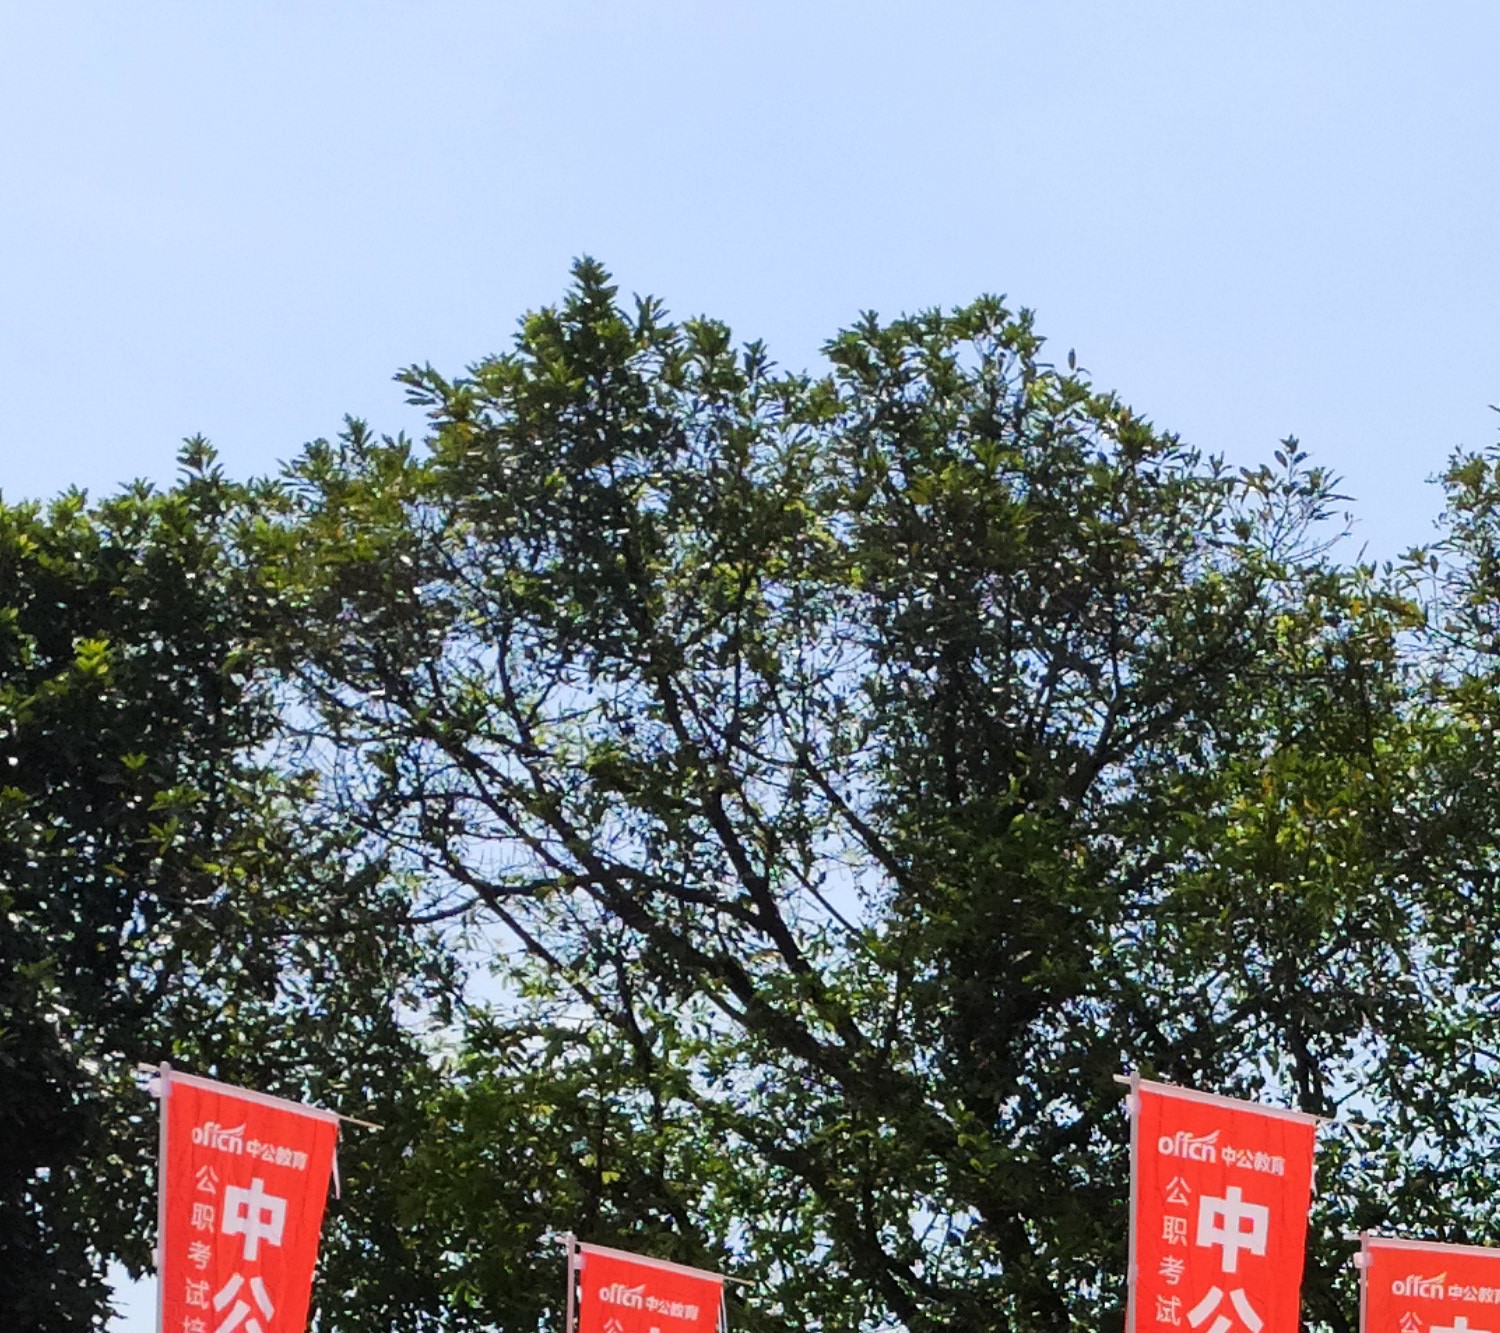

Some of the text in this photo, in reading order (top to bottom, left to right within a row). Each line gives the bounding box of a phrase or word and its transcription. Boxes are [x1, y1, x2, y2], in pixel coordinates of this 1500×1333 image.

[246, 1138, 309, 1172] 中公教育
[1157, 1130, 1286, 1178] offcn 中公教育
[1391, 1273, 1445, 1300] offcn
[645, 1294, 700, 1322] 中公教育
